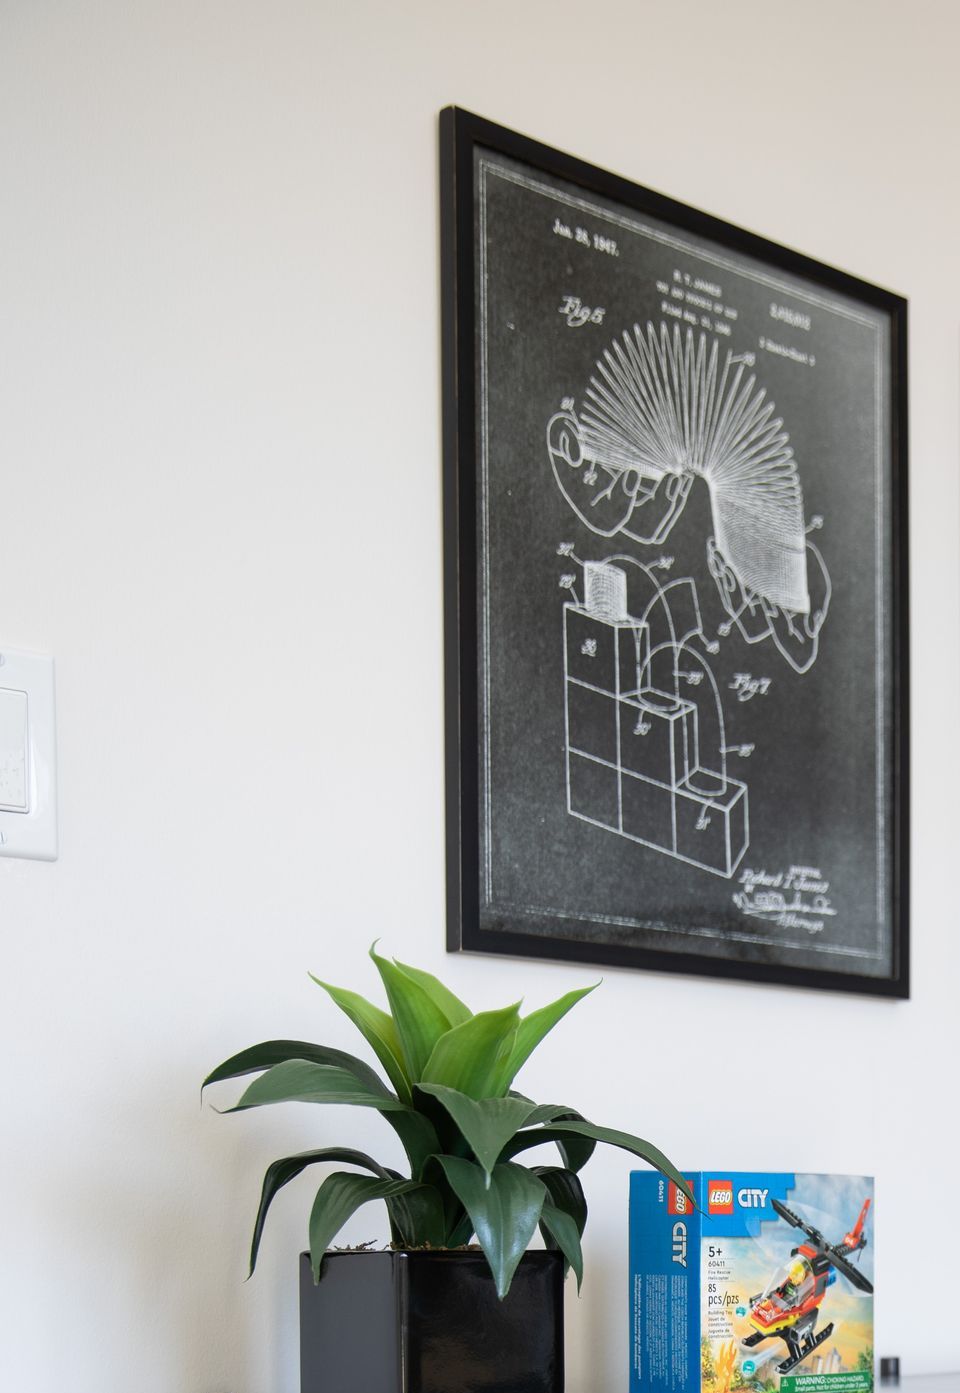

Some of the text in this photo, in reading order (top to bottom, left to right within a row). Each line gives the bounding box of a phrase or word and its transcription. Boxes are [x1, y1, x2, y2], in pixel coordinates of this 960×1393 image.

[710, 1188, 769, 1208] LEGO CITY
[672, 1221, 688, 1269] CITY
[708, 1246, 723, 1258] 5+
[708, 1260, 725, 1268] 60411
[708, 1284, 717, 1293] 85
[708, 1291, 740, 1307] pcs/pzs
[795, 1376, 826, 1385] WARNING:
